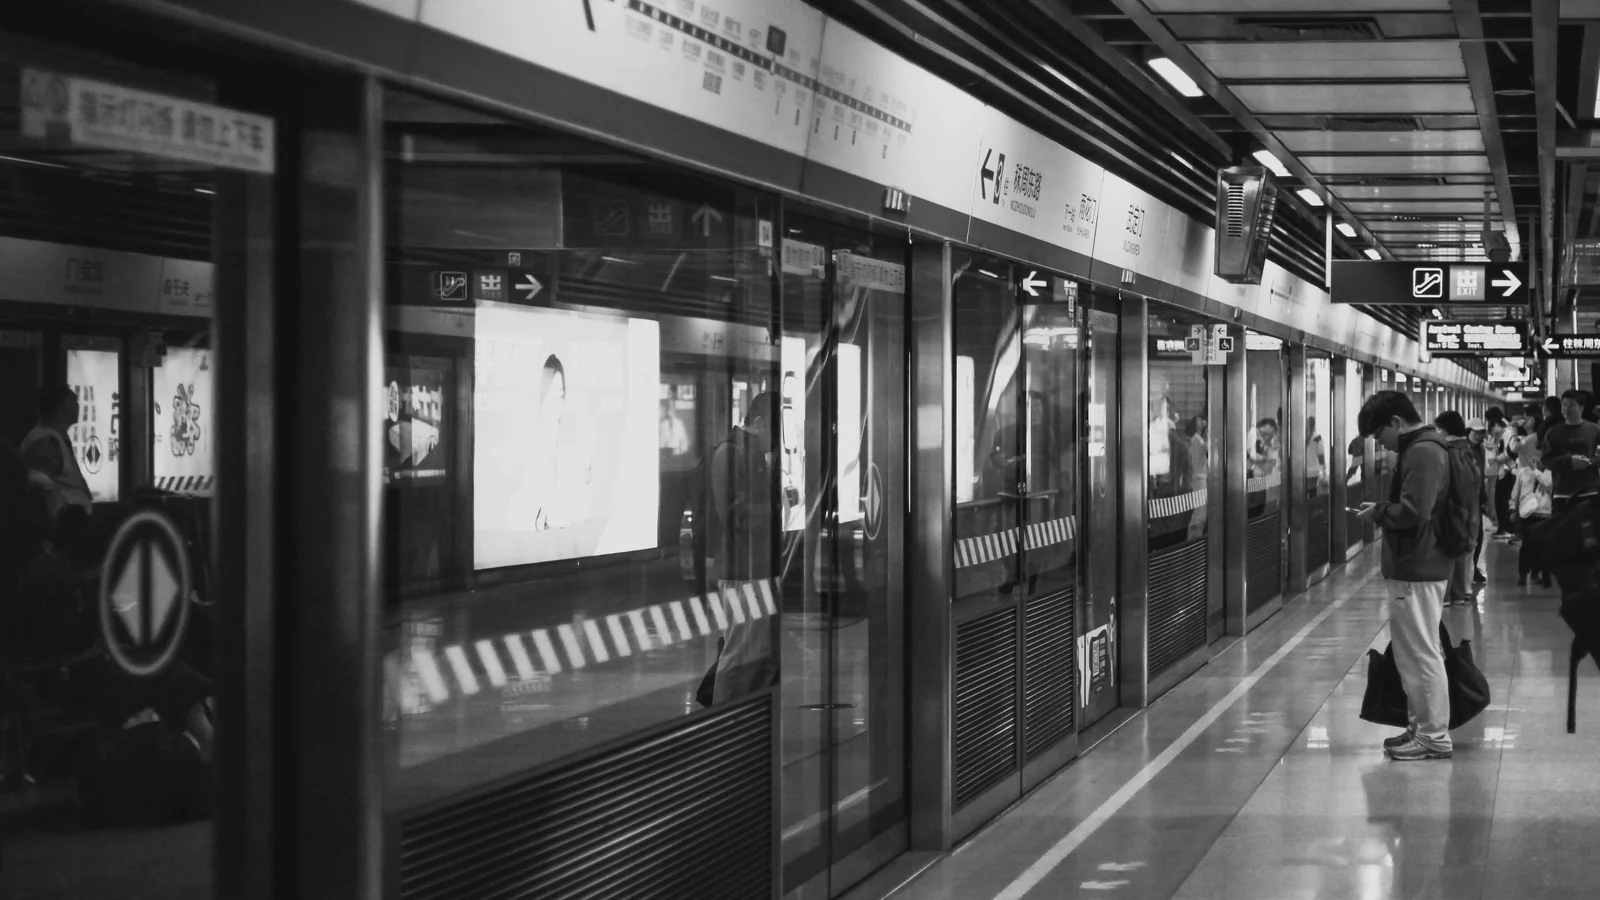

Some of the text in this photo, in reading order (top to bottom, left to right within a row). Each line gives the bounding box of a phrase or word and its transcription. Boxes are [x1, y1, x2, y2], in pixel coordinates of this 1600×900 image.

[995, 161, 1004, 199] 3
[1013, 163, 1042, 202] 秣周东路
[1064, 204, 1076, 223] 下一站
[1457, 287, 1478, 296] EXIT
